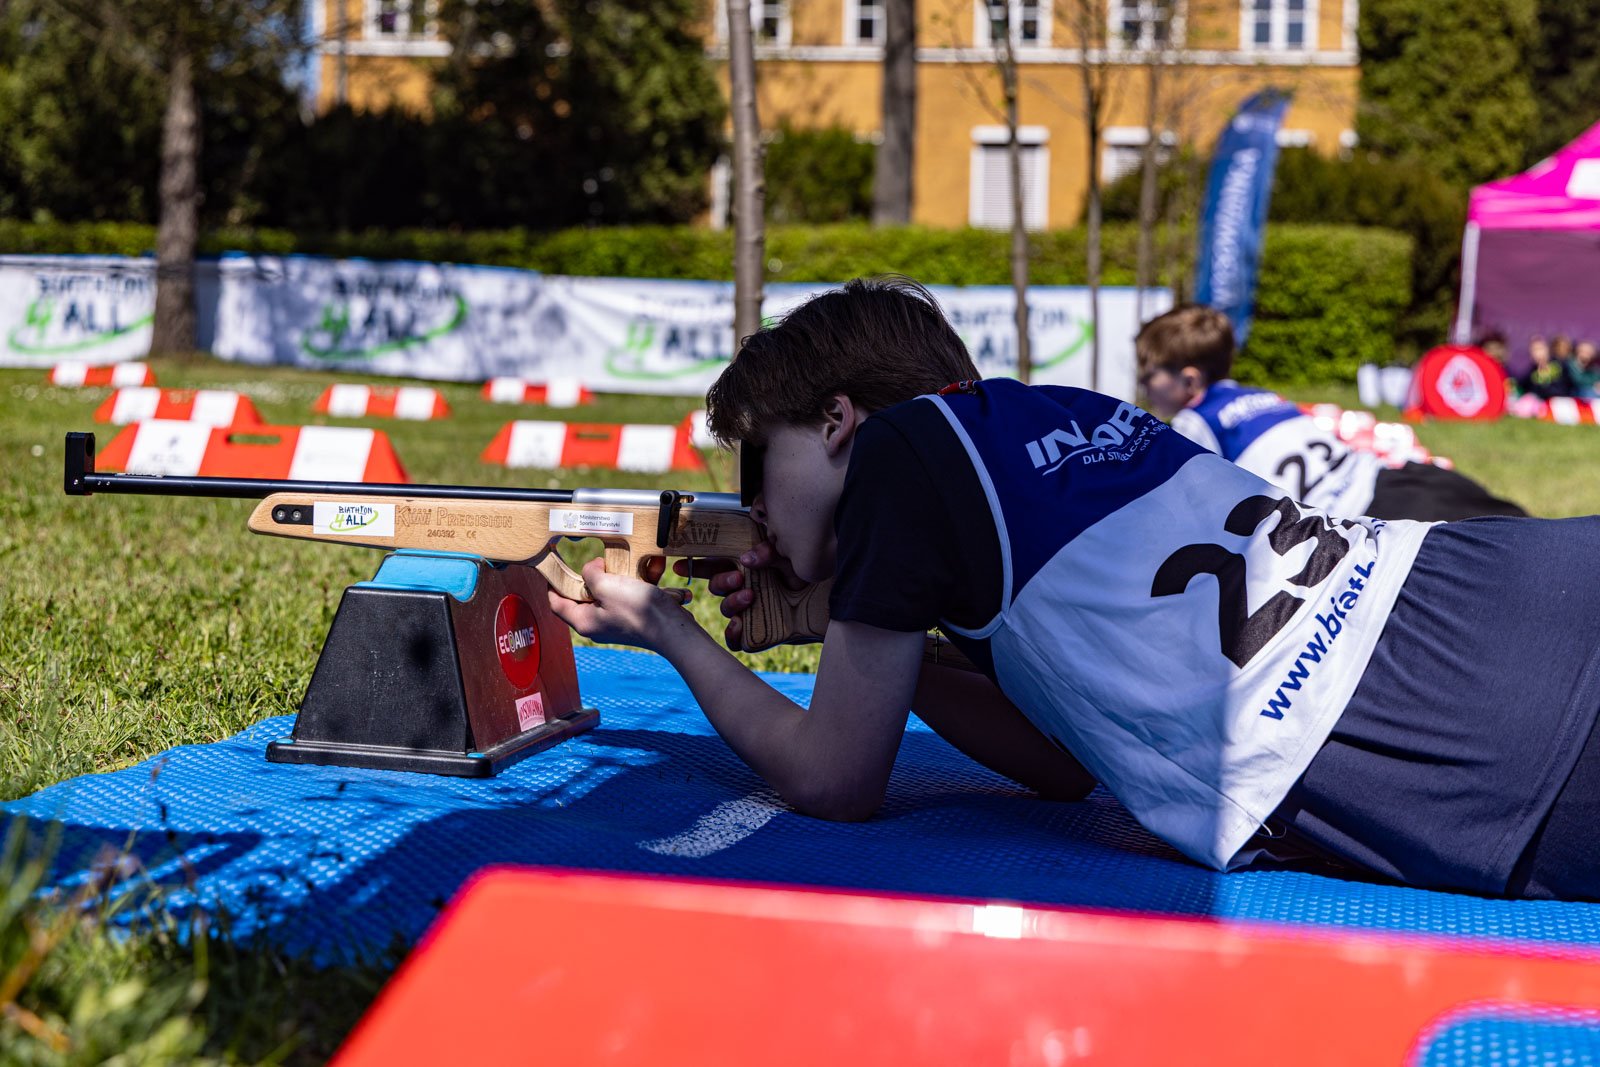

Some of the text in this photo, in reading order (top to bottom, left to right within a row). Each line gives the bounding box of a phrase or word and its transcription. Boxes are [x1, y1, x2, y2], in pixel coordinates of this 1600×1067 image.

[1082, 452, 1106, 465] DLA
[334, 514, 367, 528] 4 ALL
[1151, 495, 1349, 670] 23
